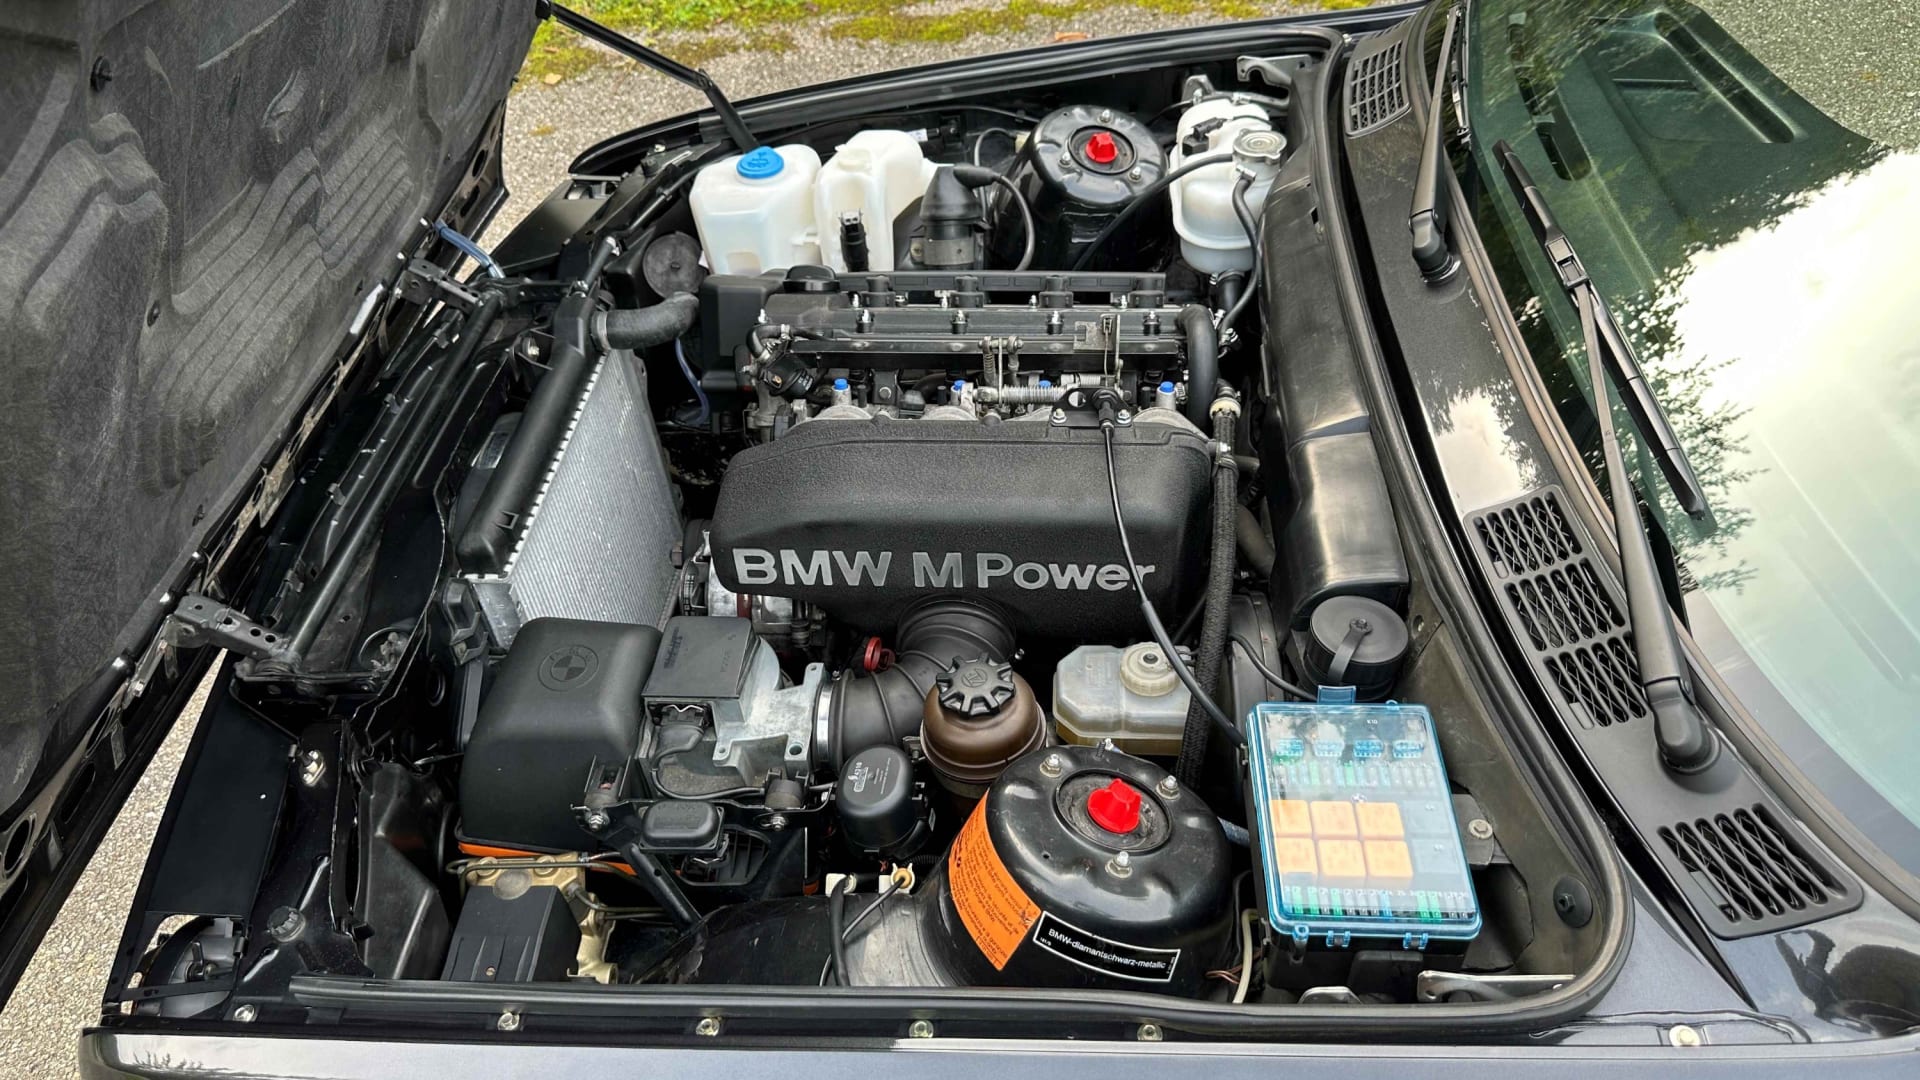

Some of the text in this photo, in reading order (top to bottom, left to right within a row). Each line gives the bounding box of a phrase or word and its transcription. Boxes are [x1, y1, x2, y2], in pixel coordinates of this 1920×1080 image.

[732, 548, 1155, 590] BMW M Power
